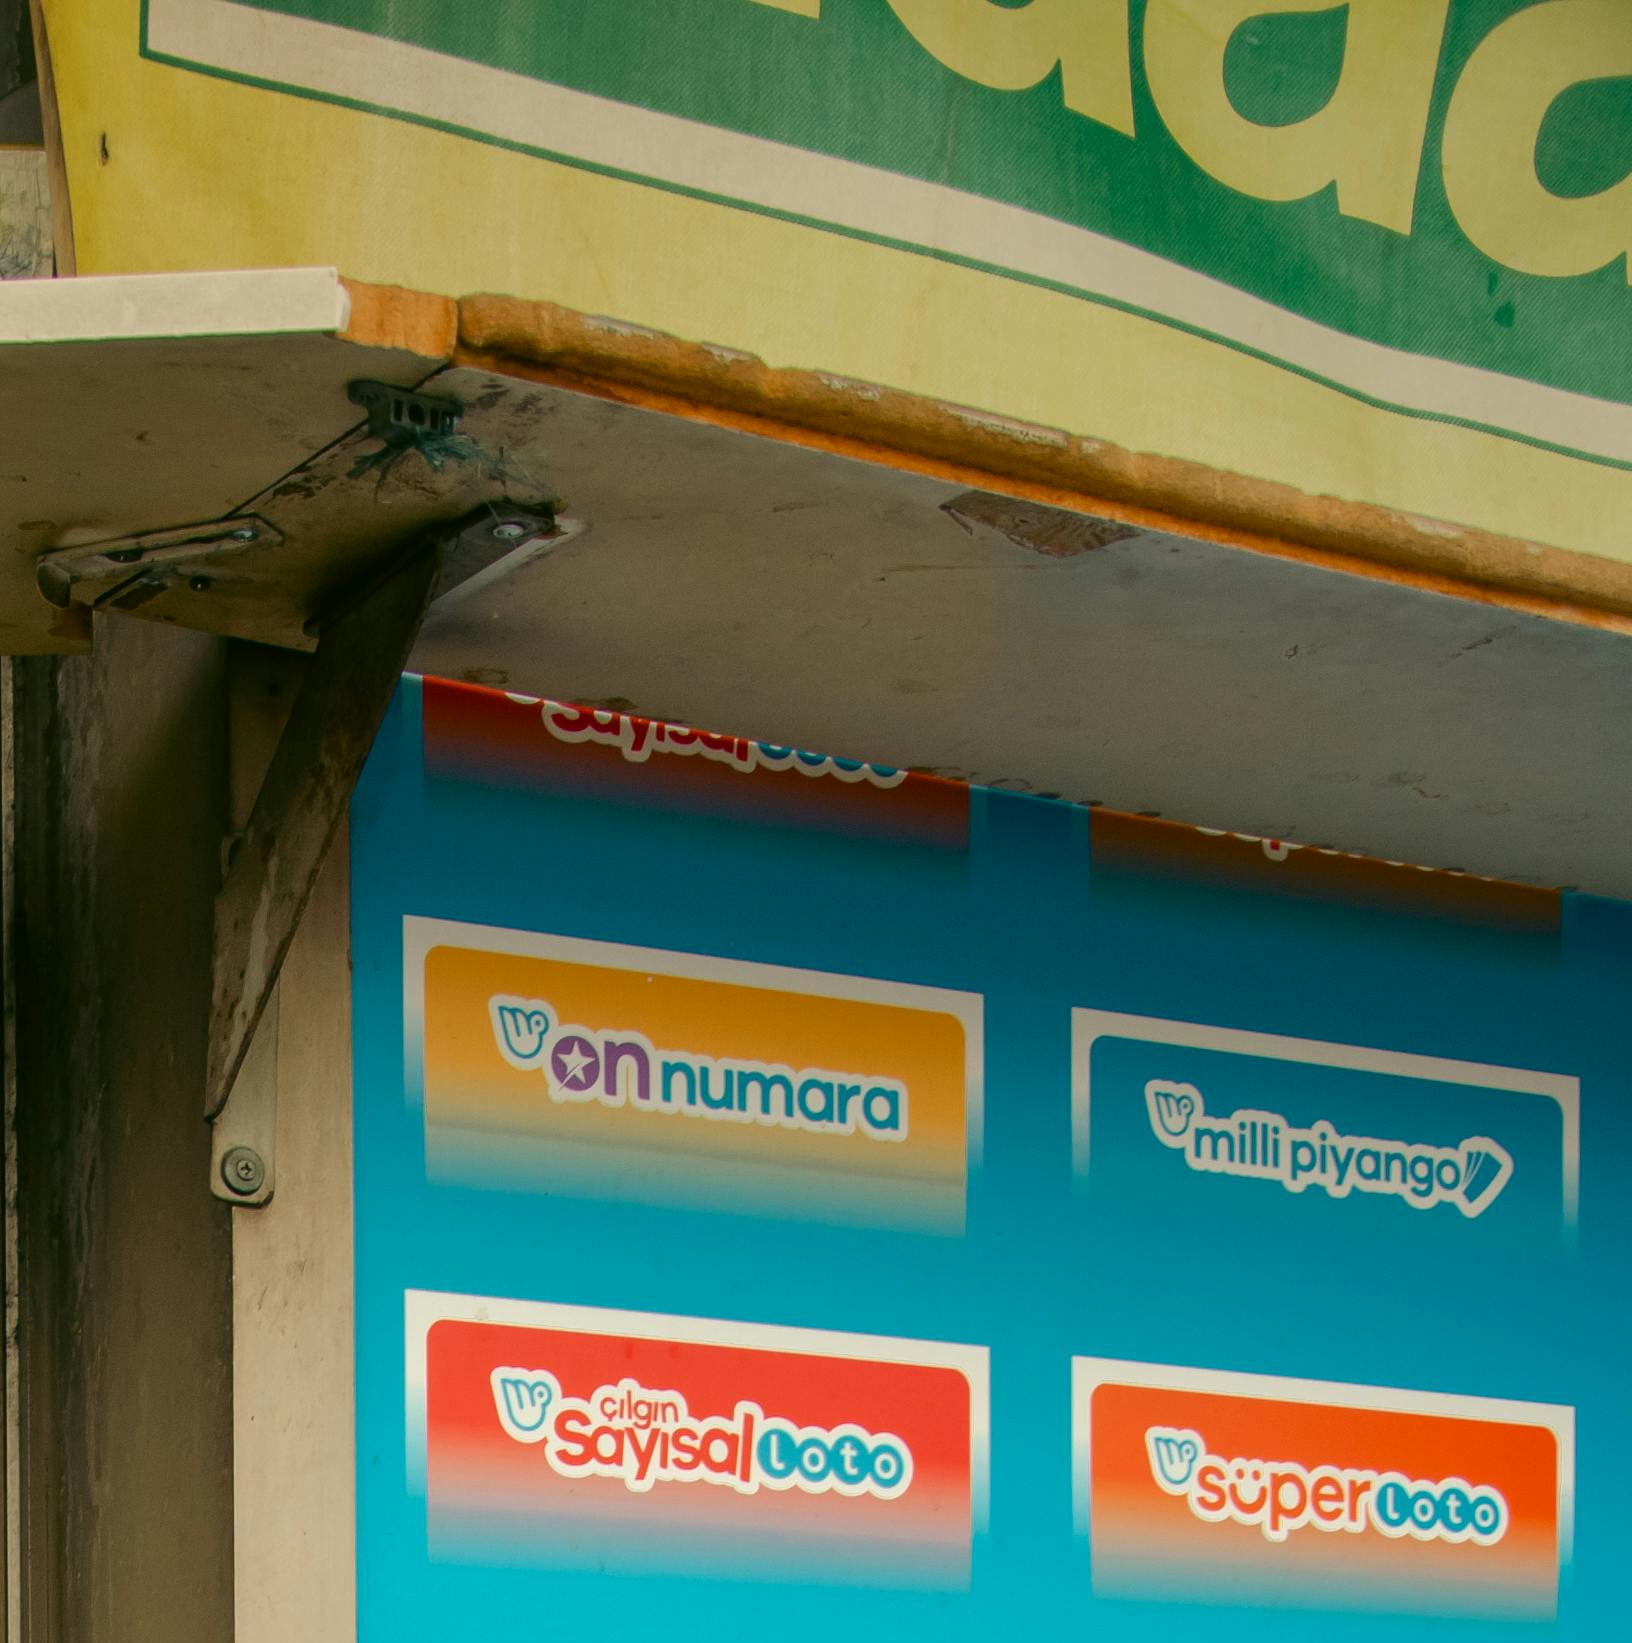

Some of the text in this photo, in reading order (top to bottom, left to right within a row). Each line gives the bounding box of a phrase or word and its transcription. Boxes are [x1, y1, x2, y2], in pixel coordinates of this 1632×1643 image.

[551, 1035, 900, 1132] on numara
[1193, 1121, 1461, 1198] milli piyango
[599, 1390, 679, 1431] çılgın
